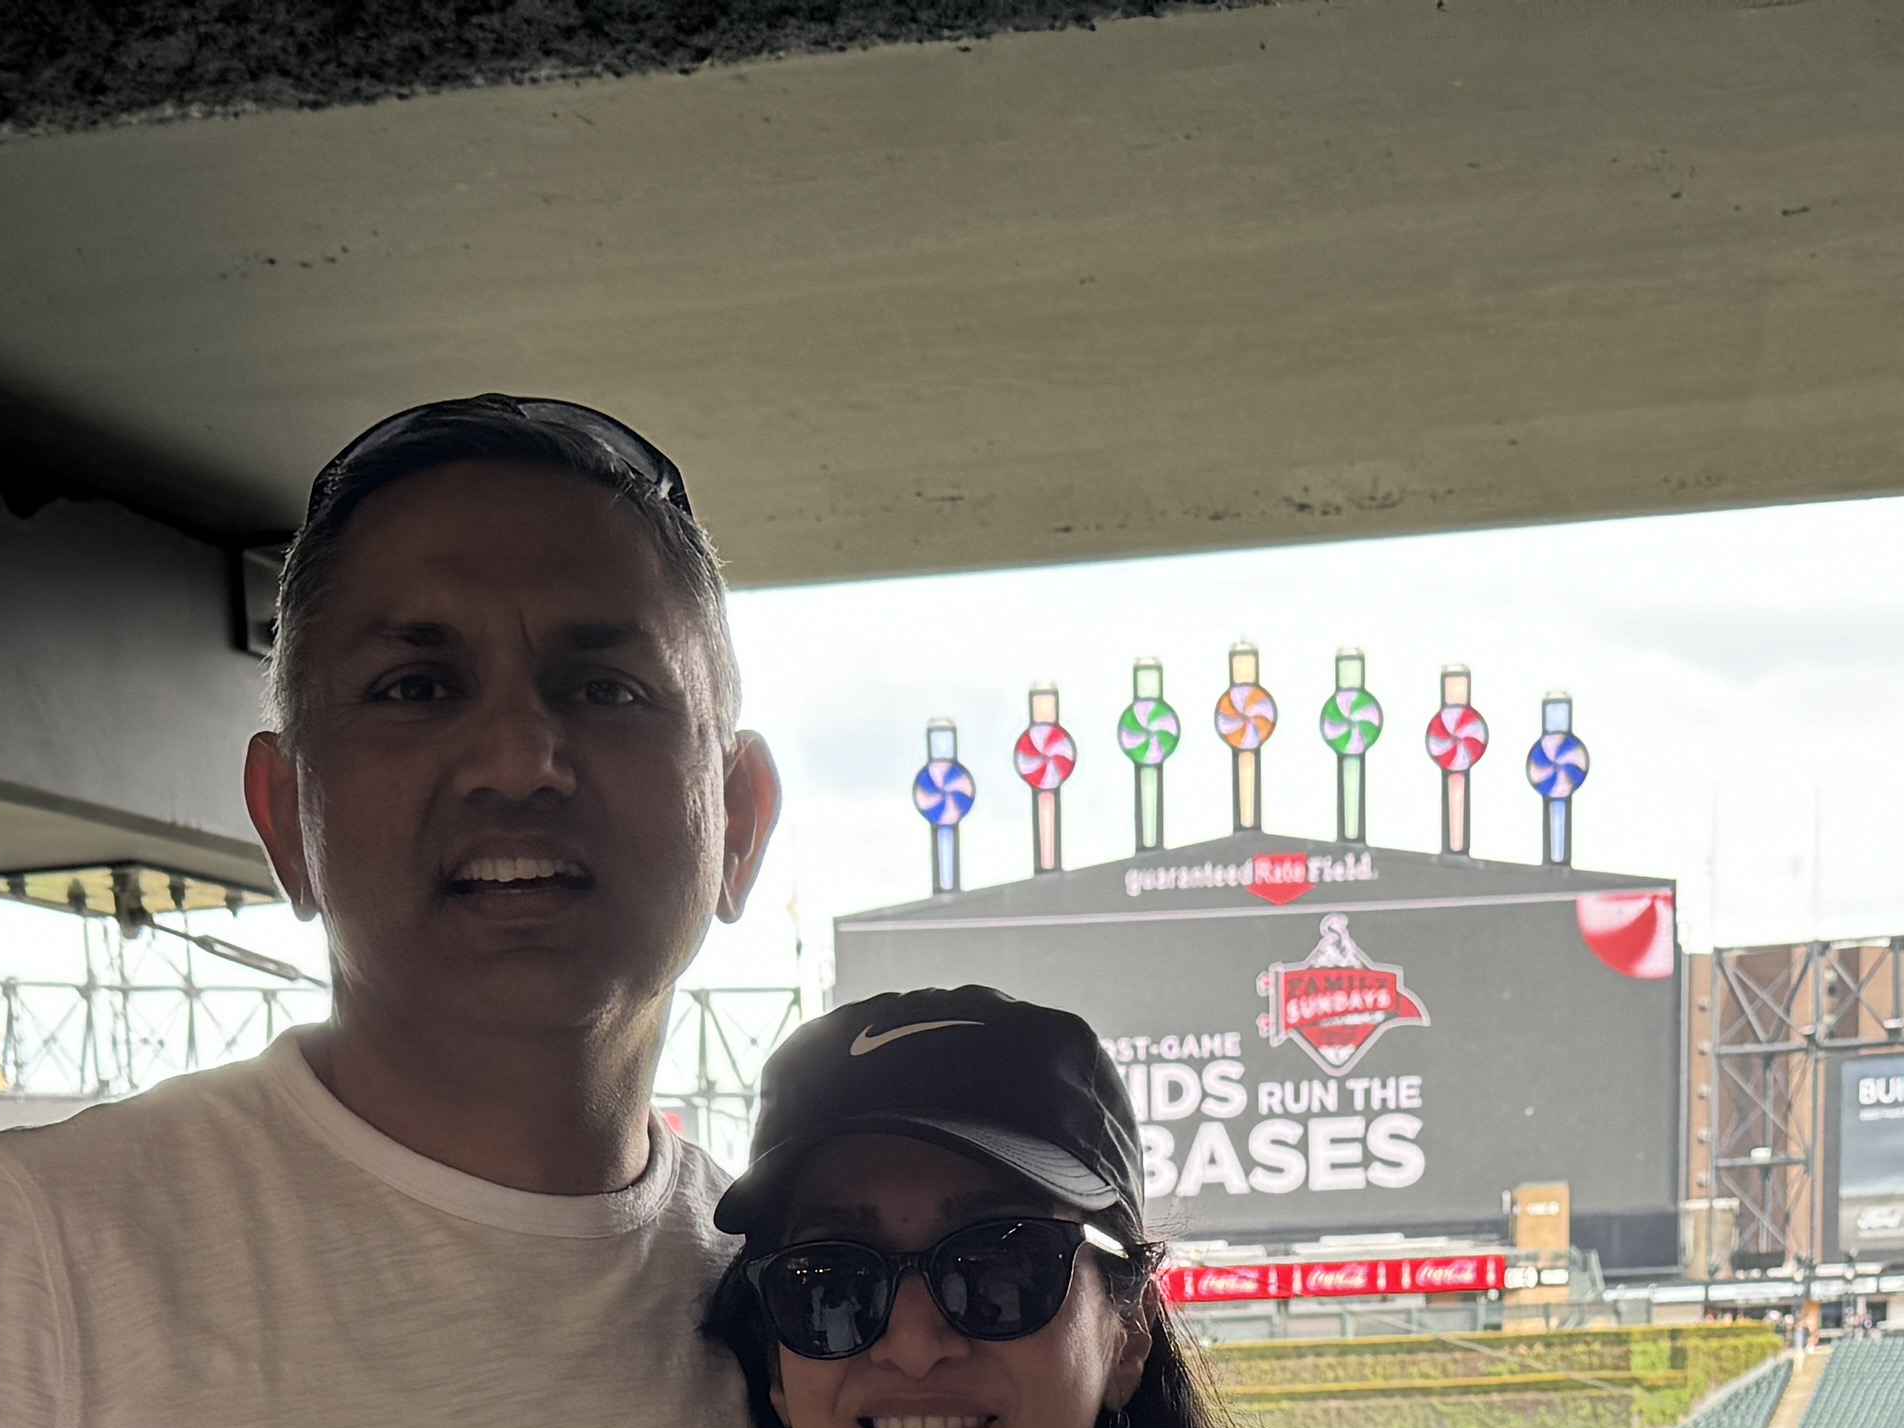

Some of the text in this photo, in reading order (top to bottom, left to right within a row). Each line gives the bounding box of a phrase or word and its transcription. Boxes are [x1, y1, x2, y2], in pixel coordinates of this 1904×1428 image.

[1125, 861, 1252, 896] guaranteed
[1286, 988, 1392, 1024] SUNDAYS
[1099, 1031, 1241, 1062] OST-GAME
[1122, 1060, 1423, 1121] IDS RUN THE
[1144, 1113, 1426, 1199] BASES
